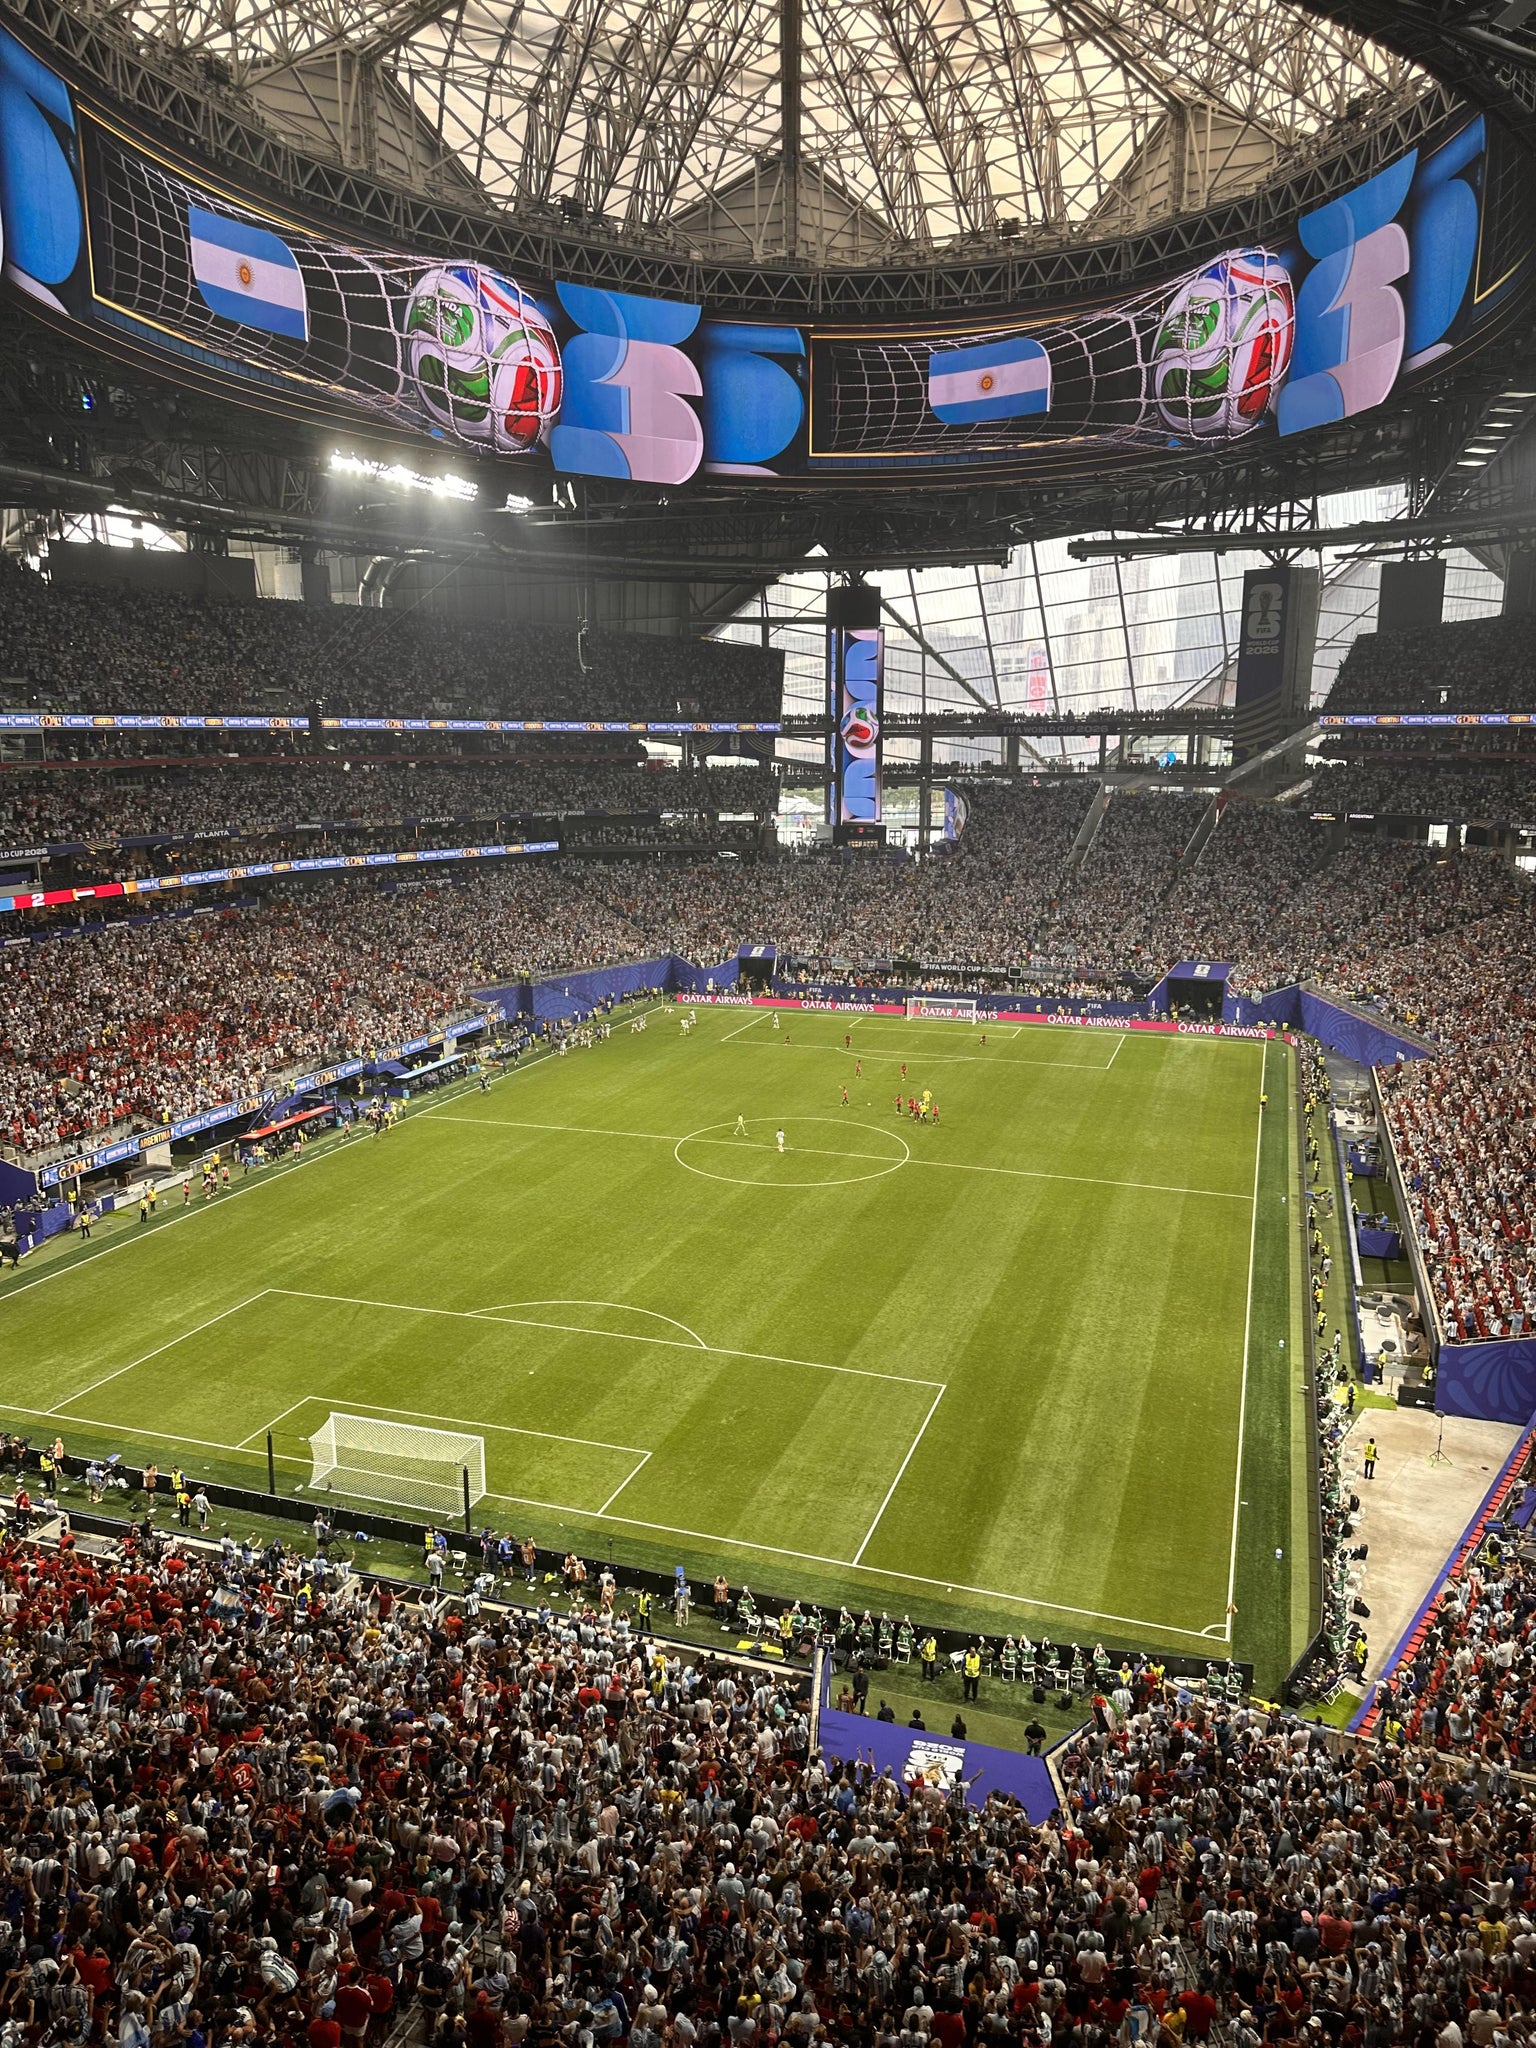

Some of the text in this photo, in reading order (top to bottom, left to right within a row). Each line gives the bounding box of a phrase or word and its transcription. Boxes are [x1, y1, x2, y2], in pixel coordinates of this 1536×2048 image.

[1246, 646, 1279, 655] 2026
[1023, 726, 1056, 734] WORLD
[1076, 725, 1109, 733] 2026
[193, 830, 230, 839] ATLANTA
[10, 850, 24, 858] CUP
[24, 847, 48, 856] 2026
[31, 893, 45, 907] 2
[925, 963, 940, 971] FIFA
[941, 964, 966, 972] WORLD
[682, 994, 753, 1005] QATAR AIRWAYS
[801, 1000, 874, 1012] QATAR AIRWAYS
[920, 1006, 998, 1020] QATAR AIRWAYS
[1047, 1014, 1130, 1028] QATAR AIRWAYS
[1178, 1023, 1267, 1038] QATAR AIRWAYS
[140, 1129, 171, 1150] ARGENTINA
[913, 1740, 966, 1754] 2026
[931, 1748, 965, 1757] WORLD
[924, 1753, 948, 1761] FIFA
[235, 1770, 250, 1785] 22
[706, 1935, 722, 1948] 33
